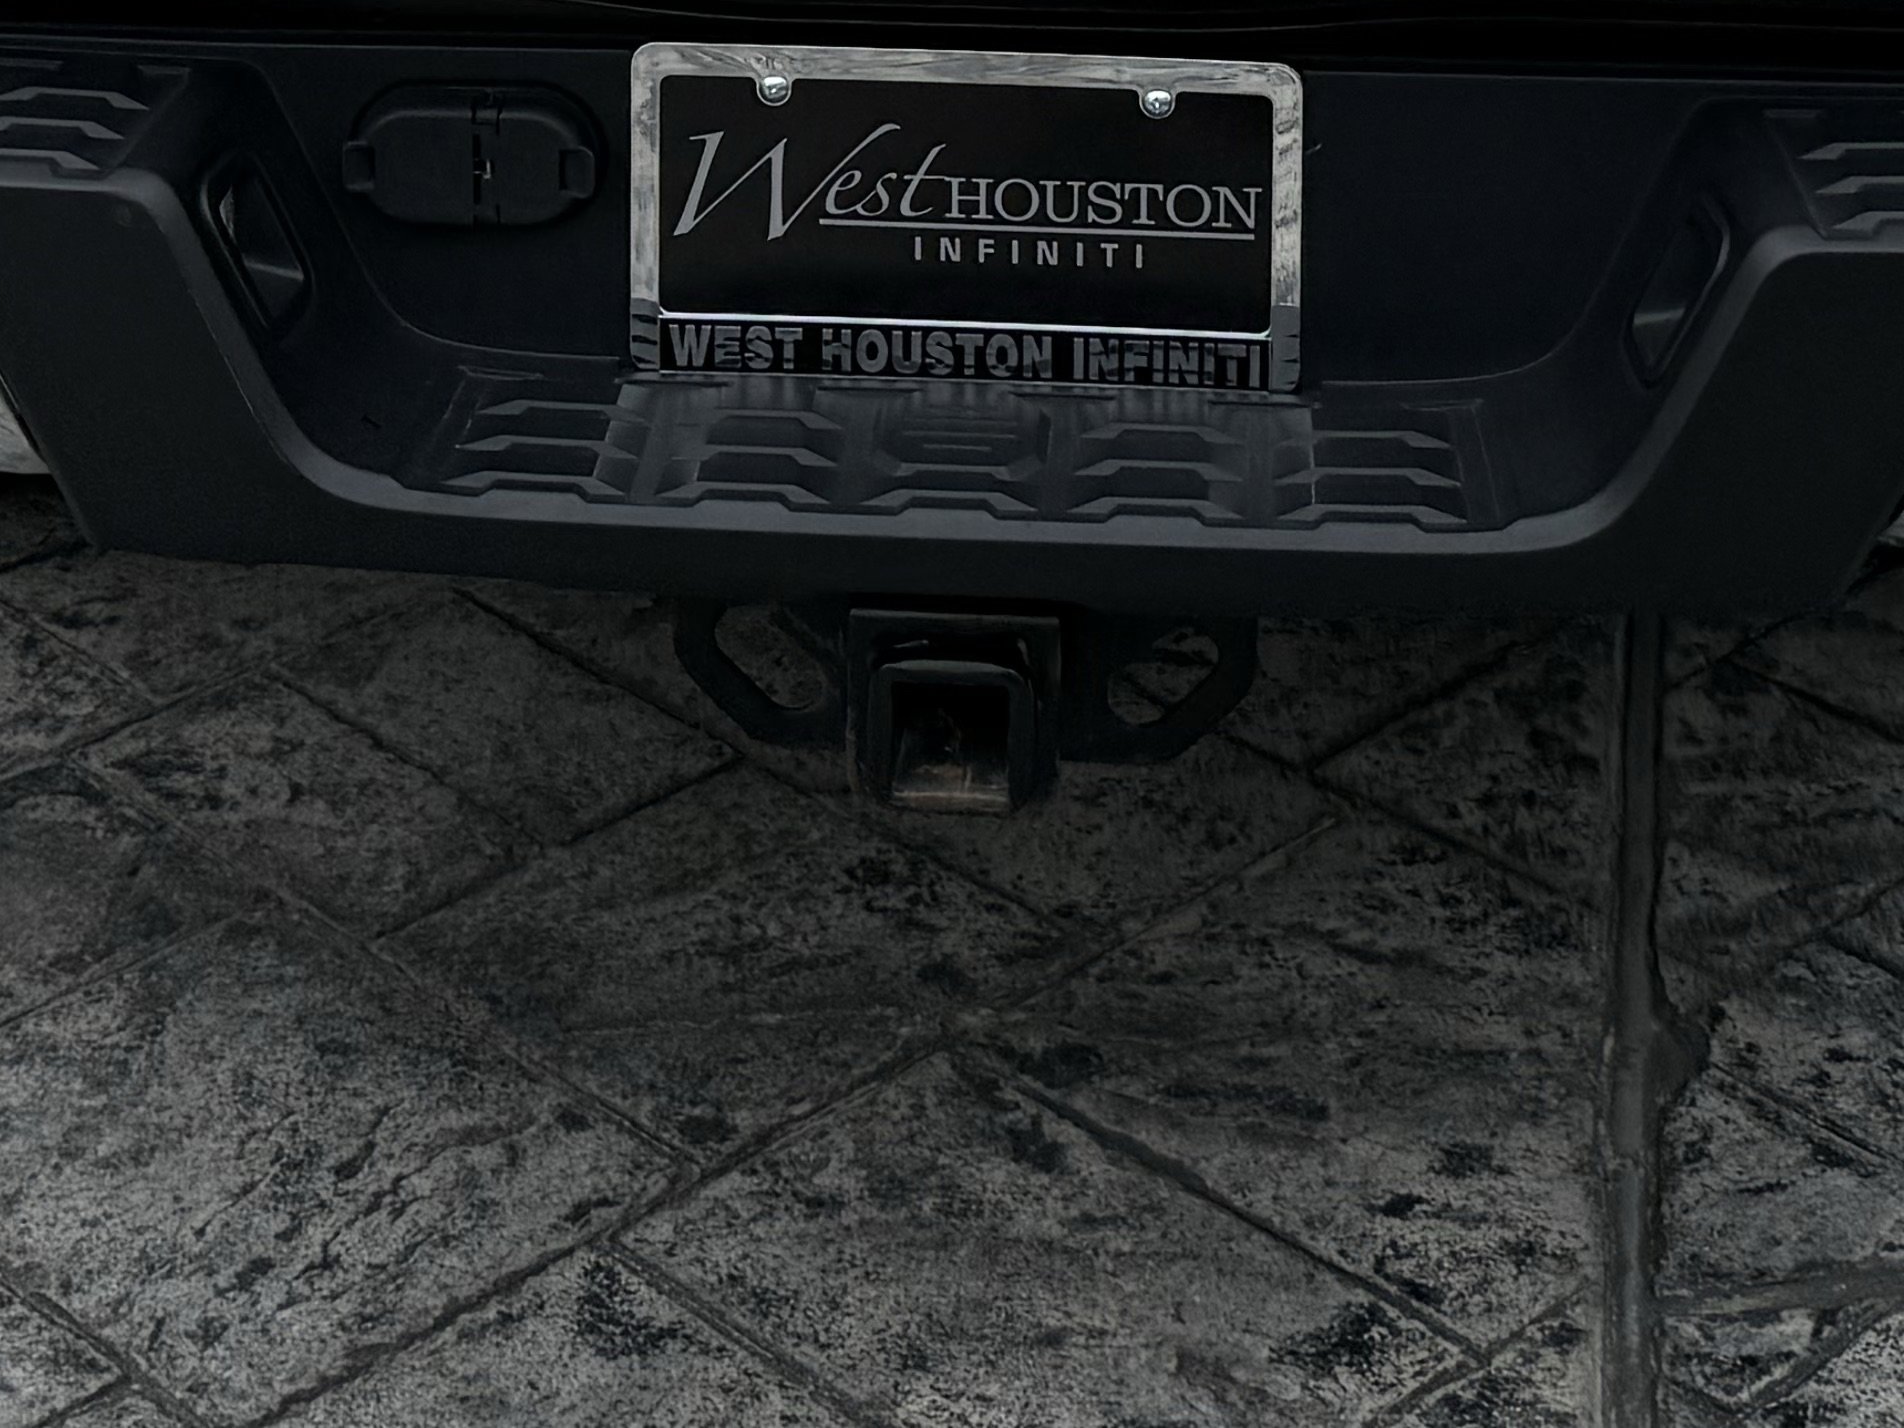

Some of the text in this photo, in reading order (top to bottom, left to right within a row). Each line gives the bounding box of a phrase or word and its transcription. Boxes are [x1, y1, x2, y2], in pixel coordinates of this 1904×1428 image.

[914, 236, 1144, 269] INFINITI
[668, 323, 1263, 389] WEST HOUSTON INFINITI
